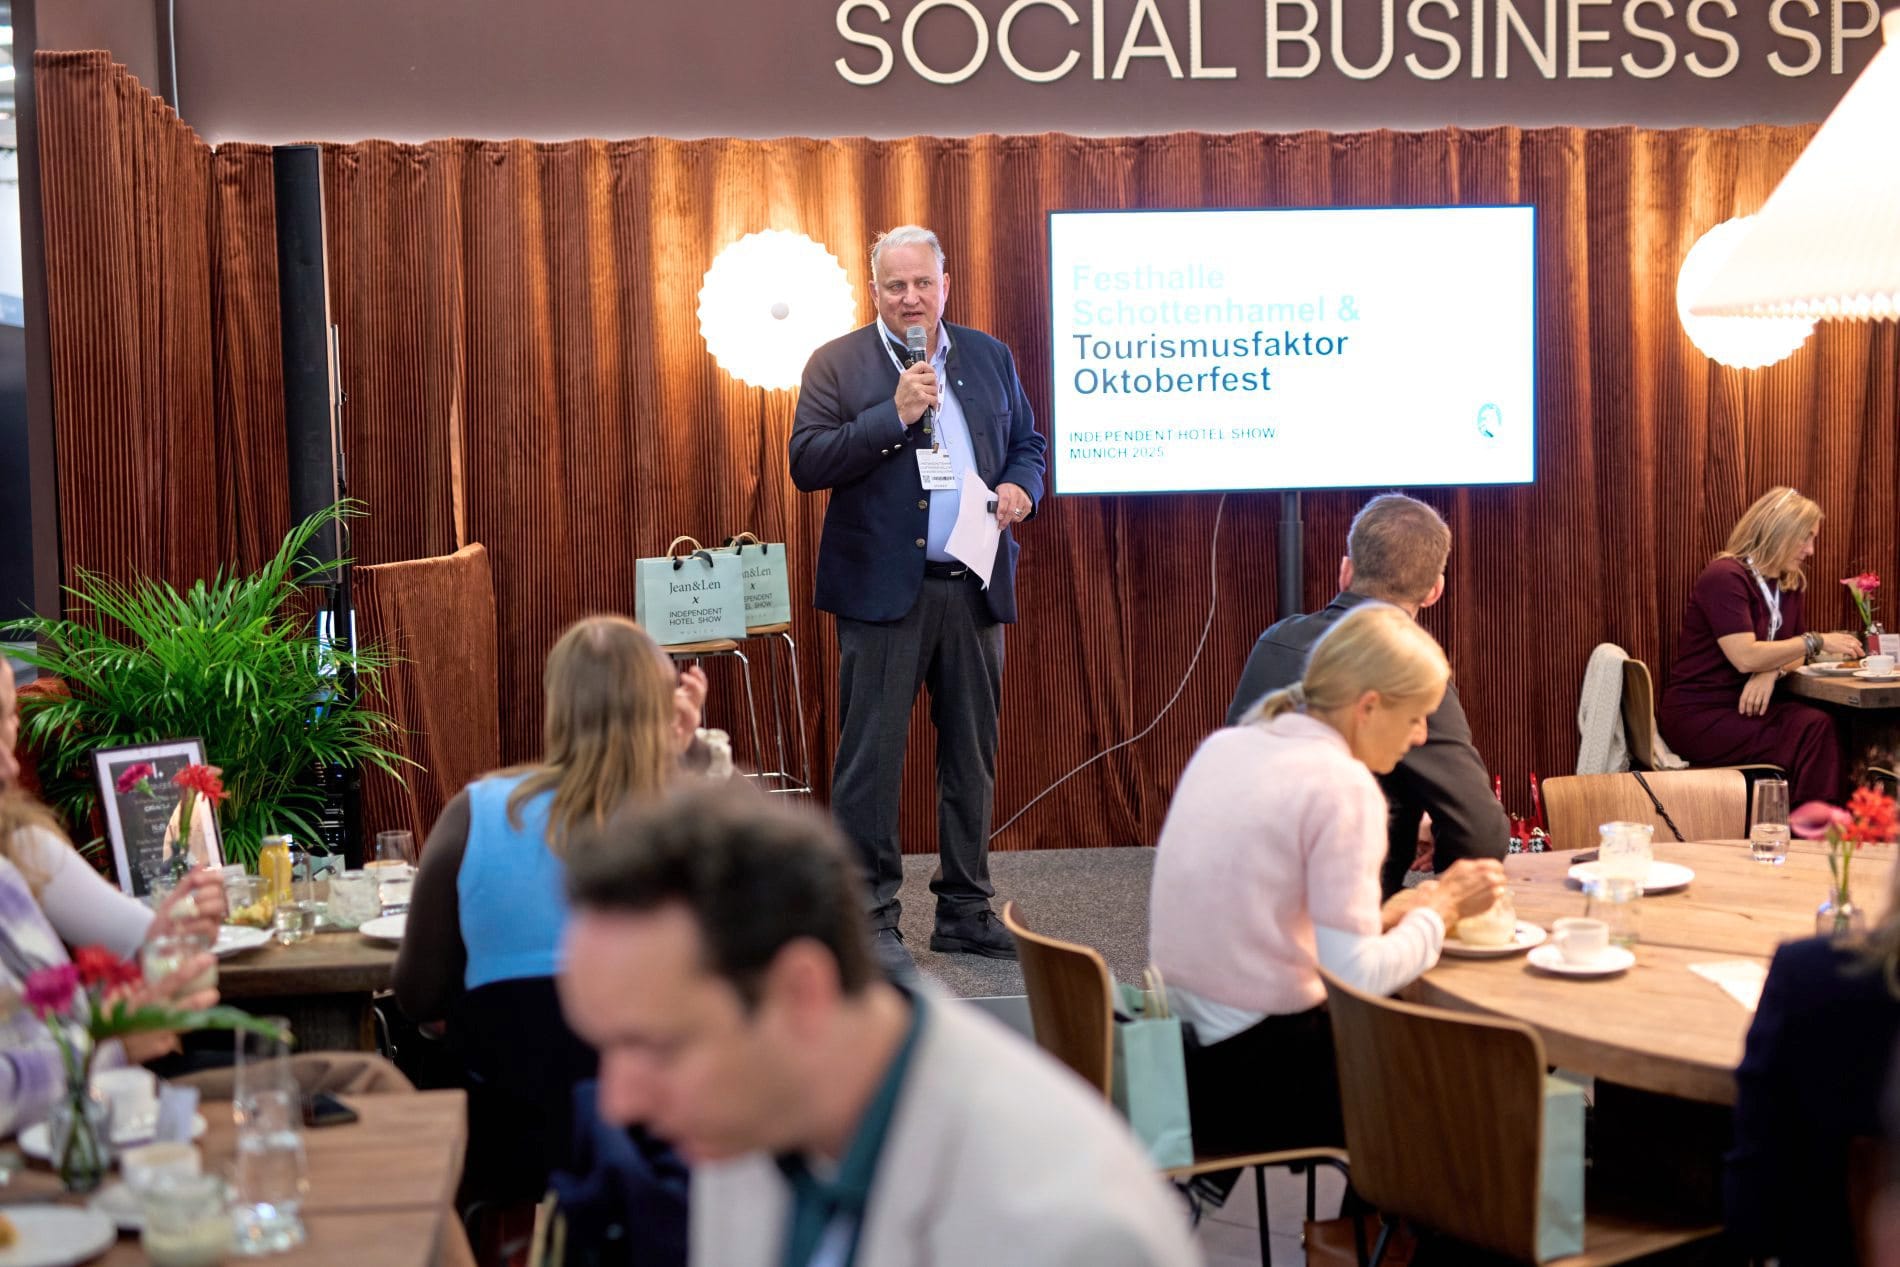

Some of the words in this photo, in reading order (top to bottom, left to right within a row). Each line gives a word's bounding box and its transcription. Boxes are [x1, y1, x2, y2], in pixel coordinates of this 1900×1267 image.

[835, 0, 1237, 85] SOCIAL
[1266, 0, 1740, 79] BUSINESS
[1072, 264, 1225, 291] Festhalle
[1072, 296, 1325, 327] Schottenhamel
[1336, 295, 1361, 322] &
[1072, 330, 1349, 360] Tourismusfaktor
[1073, 366, 1272, 395] Oktoberfest
[1069, 429, 1172, 443] INDEPENDENT
[1178, 428, 1226, 441] HOTEL
[1231, 427, 1276, 440] SHOW
[1069, 447, 1128, 460] MUNICH
[1132, 446, 1165, 459] 2025
[669, 579, 721, 595] Jean&Len
[669, 607, 722, 618] INDEPENDENT
[669, 618, 694, 626] HOTEL
[697, 615, 721, 625] SHOW
